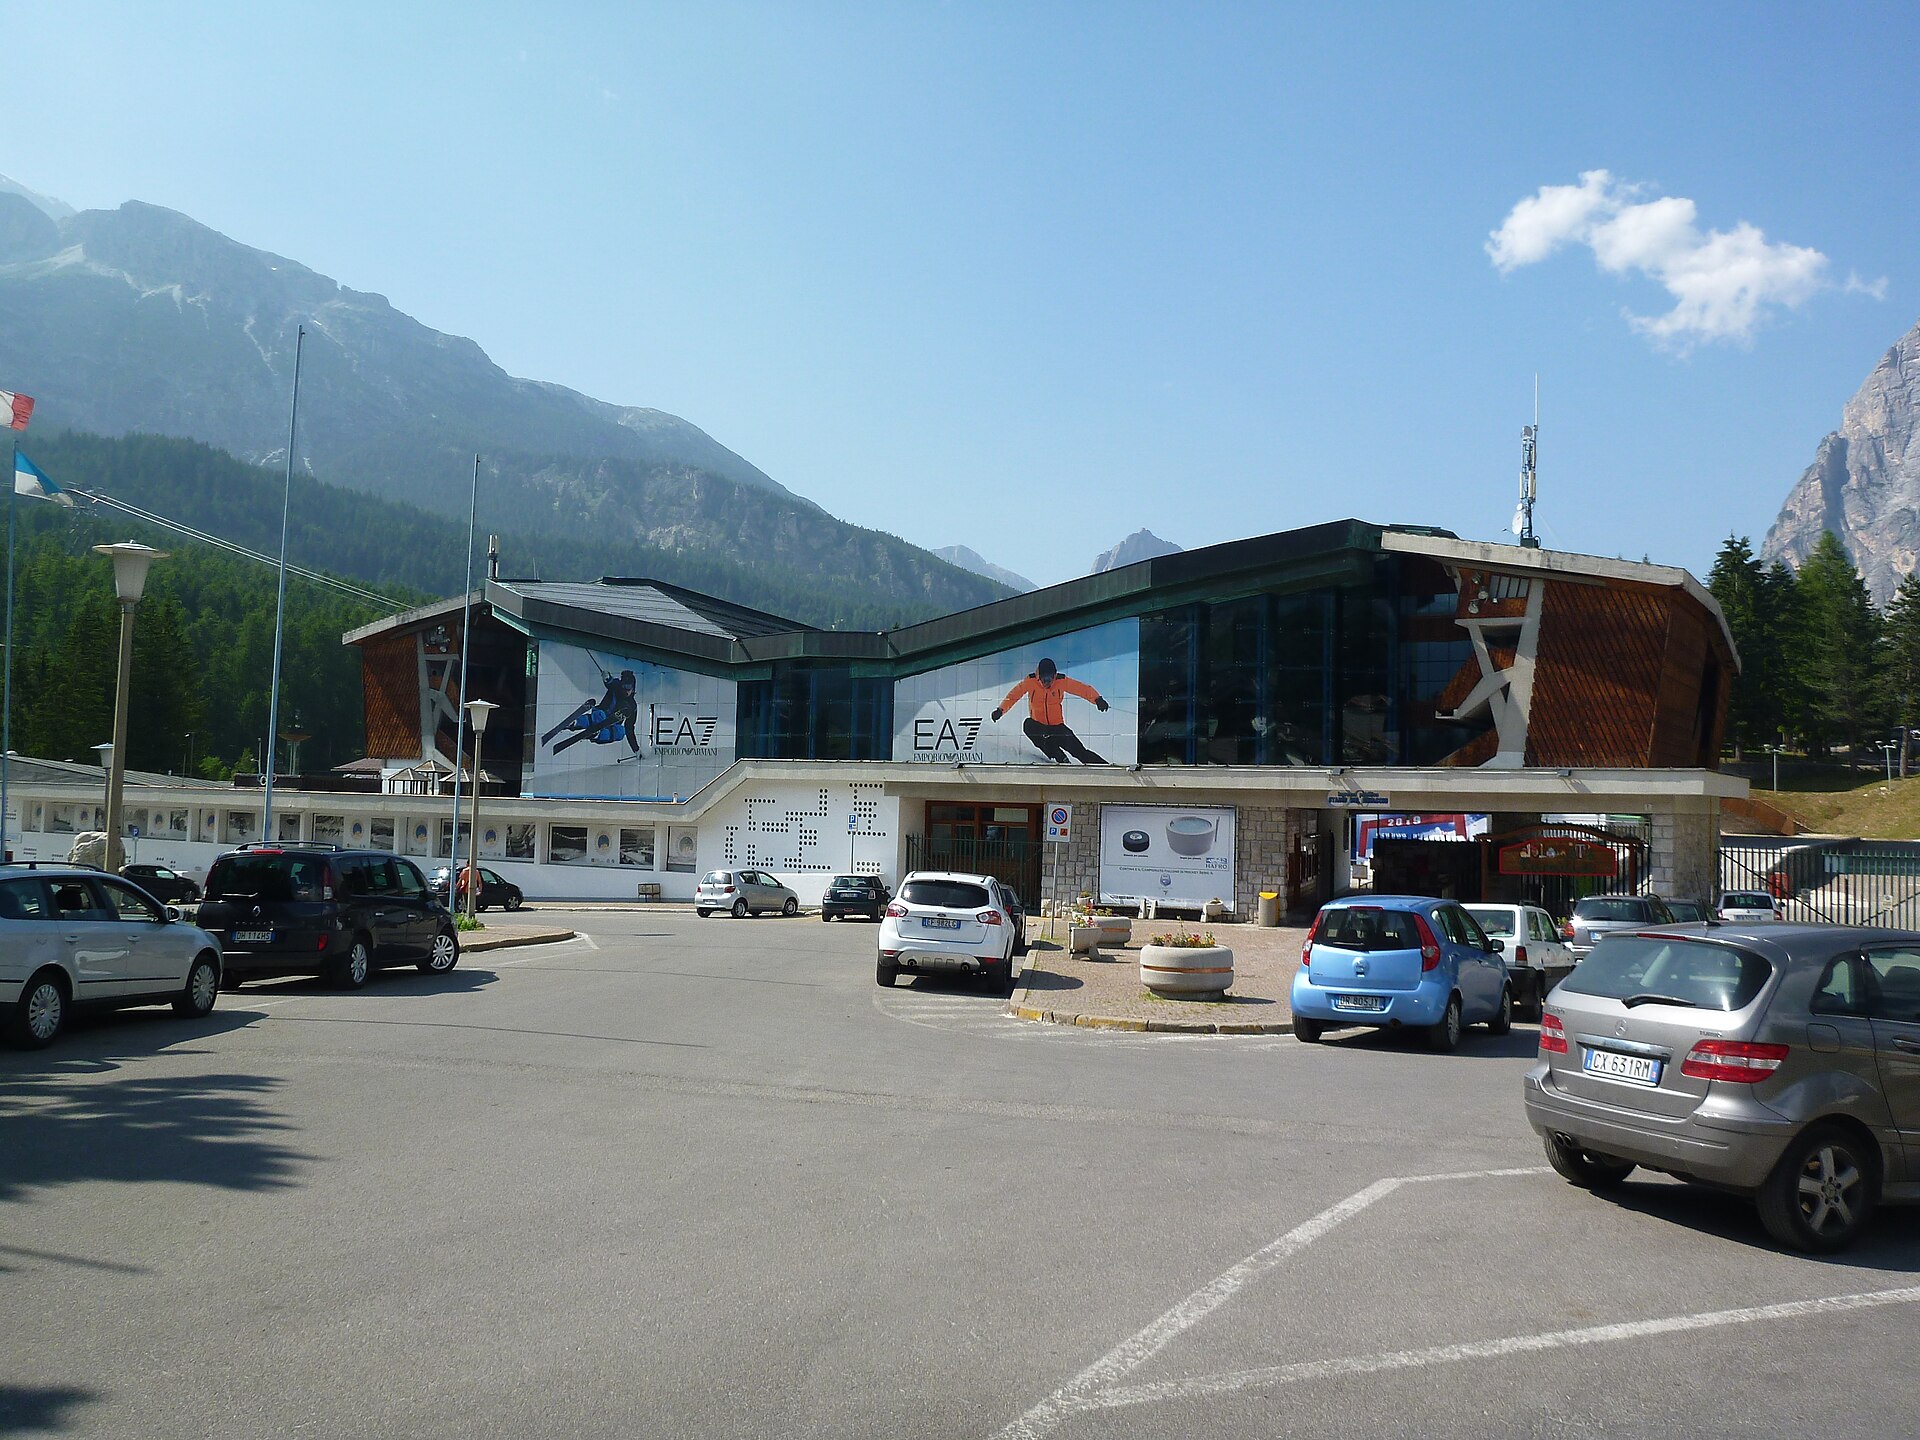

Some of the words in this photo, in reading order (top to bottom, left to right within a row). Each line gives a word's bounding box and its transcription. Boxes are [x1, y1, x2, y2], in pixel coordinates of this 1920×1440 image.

[656, 717, 718, 745] EA7
[914, 717, 983, 750] EA7
[655, 747, 685, 755] EMPORIO
[693, 748, 718, 756] ARMANI
[913, 752, 946, 761] EMPORIO
[955, 752, 983, 761] ARMANI
[1593, 1053, 1608, 1070] CX
[1611, 1056, 1651, 1078] 631RM
